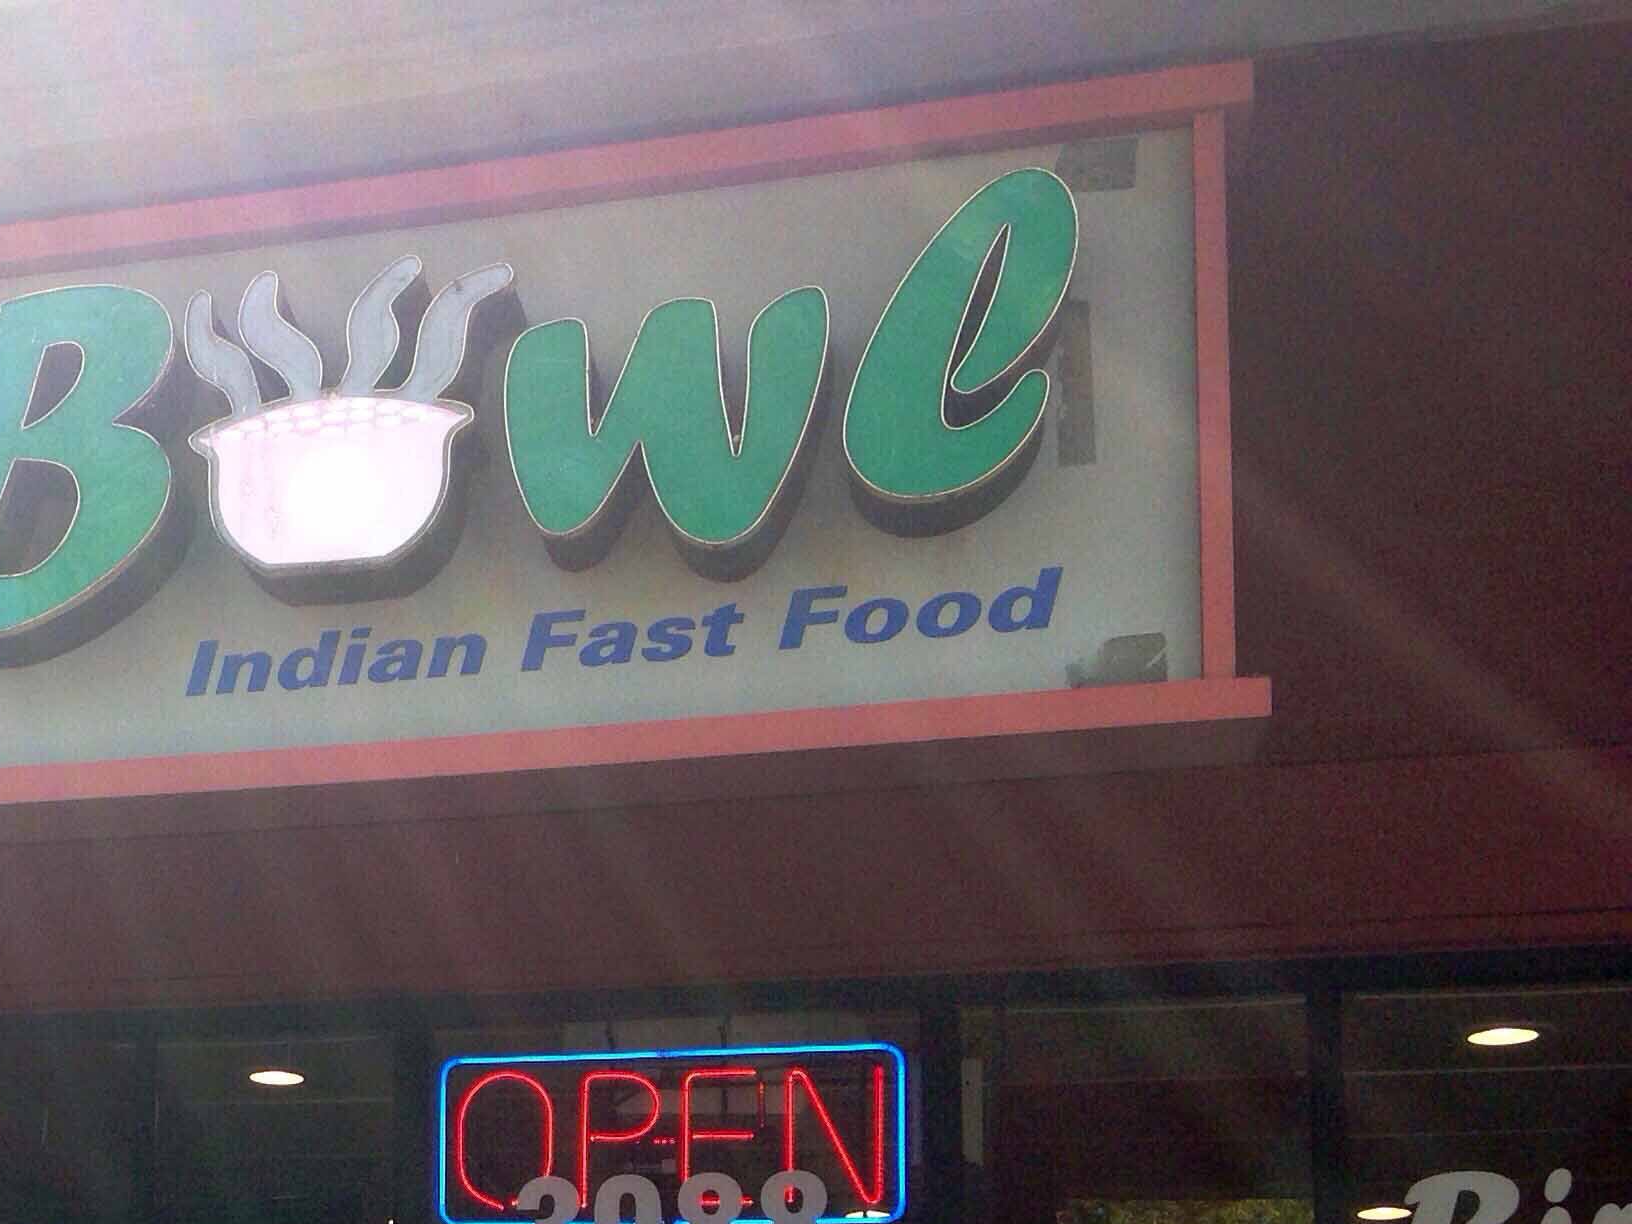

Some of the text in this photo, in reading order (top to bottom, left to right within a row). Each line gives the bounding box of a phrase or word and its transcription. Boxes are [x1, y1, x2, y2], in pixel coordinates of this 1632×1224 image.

[184, 567, 1064, 697] Indian Fast Food
[454, 1063, 886, 1211] OPEN
